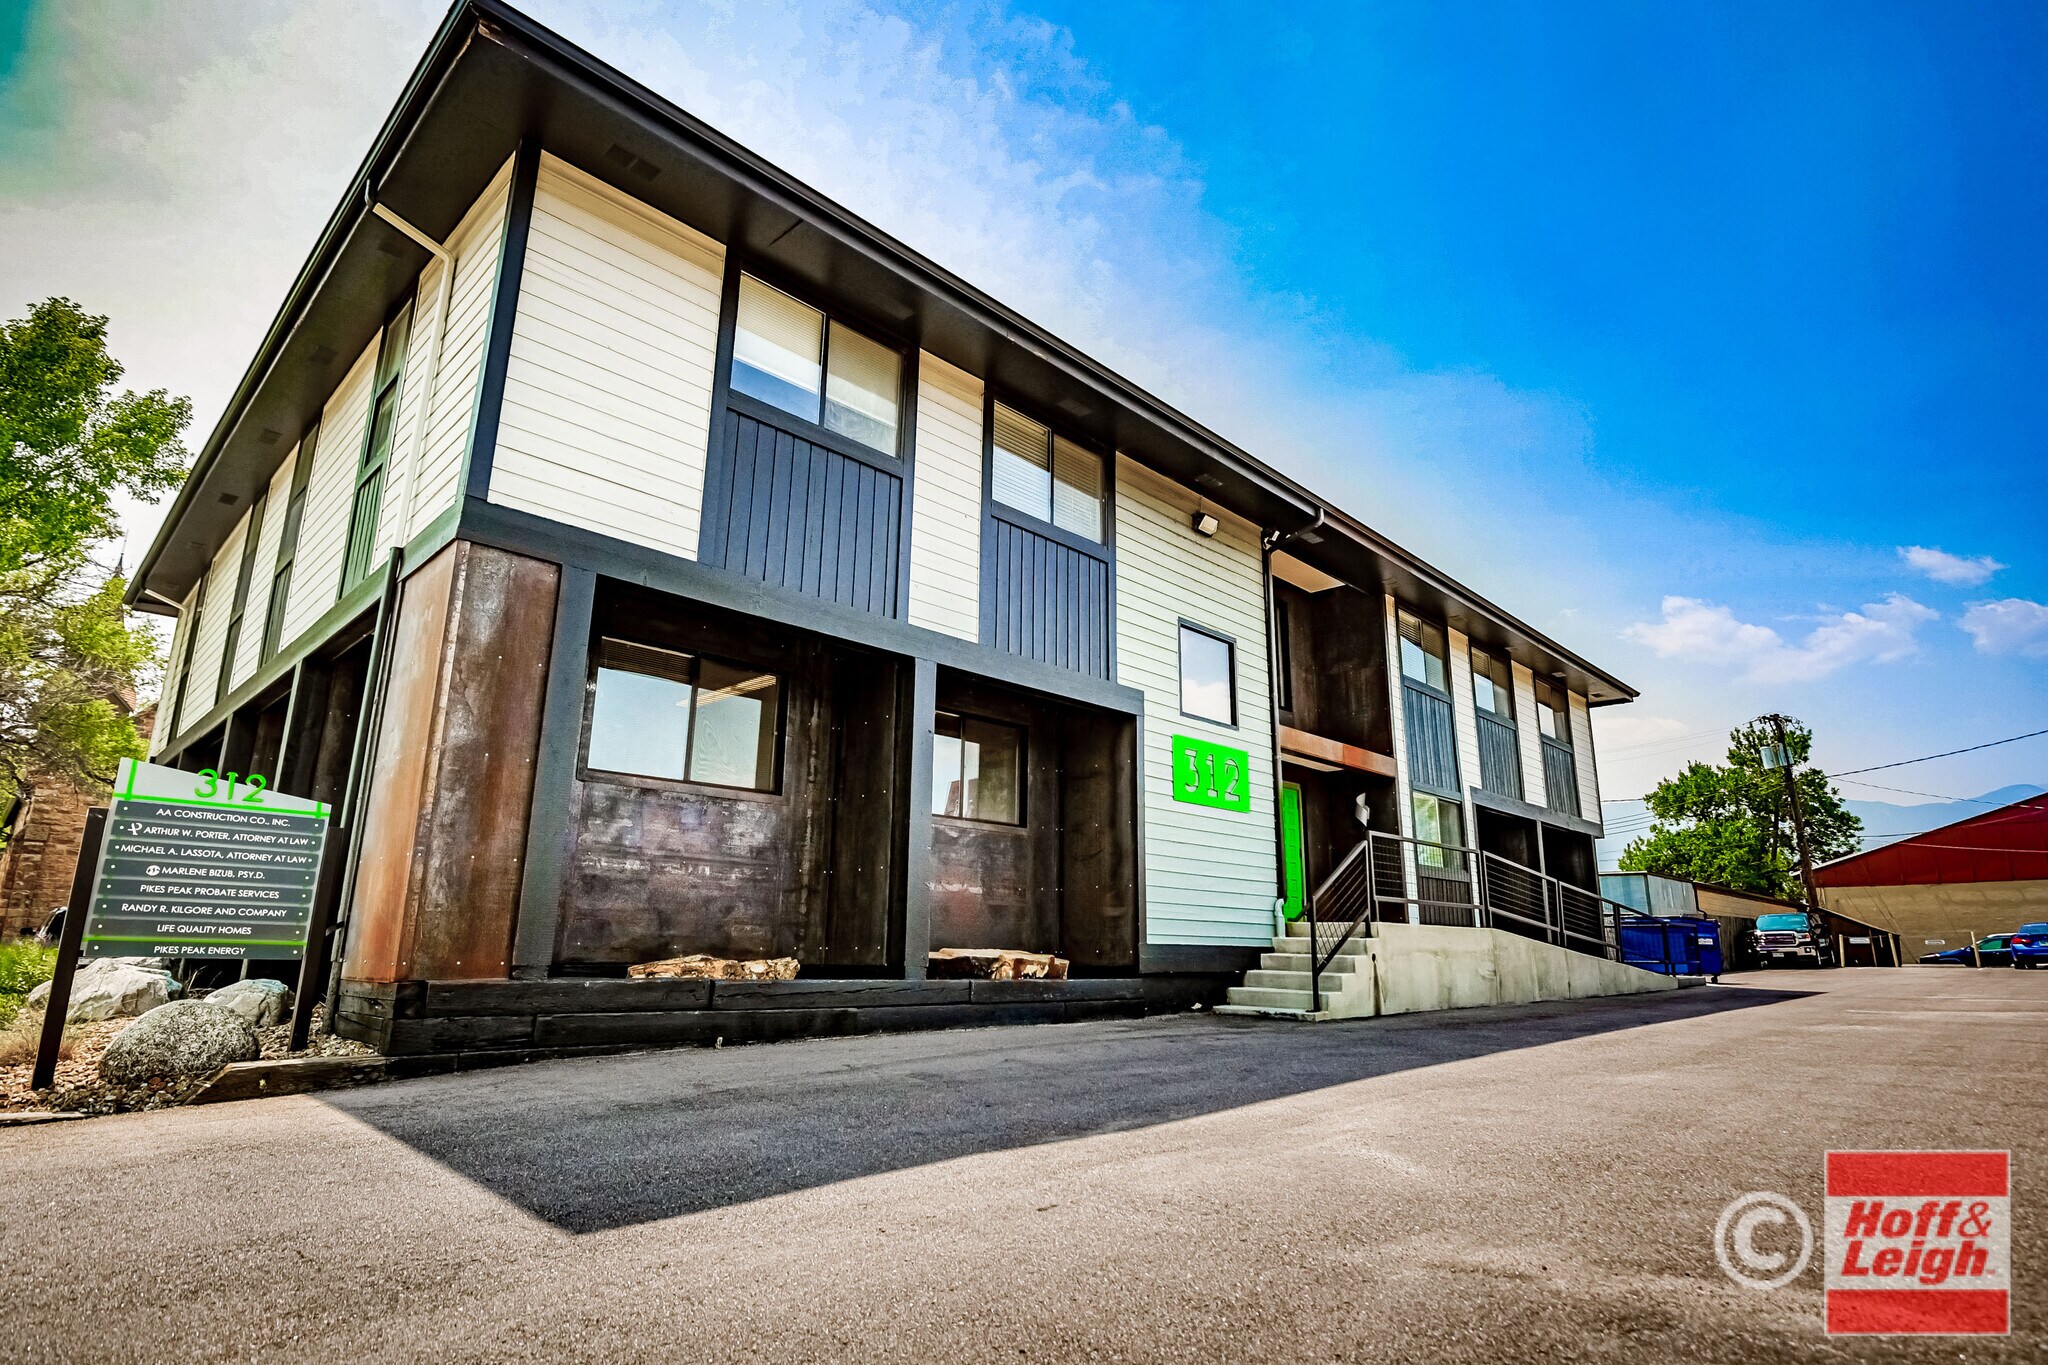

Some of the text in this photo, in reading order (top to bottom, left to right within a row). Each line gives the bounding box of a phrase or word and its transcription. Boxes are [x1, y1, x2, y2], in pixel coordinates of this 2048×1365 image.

[1184, 747, 1240, 802] 312
[194, 768, 267, 803] 312
[156, 808, 172, 816] AA
[174, 809, 248, 823] CONSTRUCTION
[272, 818, 291, 827] INC.
[143, 826, 180, 836] ARTHUR
[181, 829, 193, 837] W.
[232, 833, 276, 843] ATTORNEY
[277, 836, 289, 844] AT
[289, 837, 309, 845] LAW
[120, 844, 166, 855] MICHAEL
[226, 851, 273, 862] ATTORNEY
[287, 855, 307, 863] LAW
[161, 866, 208, 876] MARLENE
[237, 870, 266, 879] PSY.D.
[140, 884, 280, 899] PIKES PEAK PROBATE SERVICES
[121, 903, 287, 917] RANDY R. KILGORE AND COMPANY
[156, 924, 252, 935] LIFE QUALITY HOMES
[153, 945, 246, 955] PIKES PEAK ENERGY
